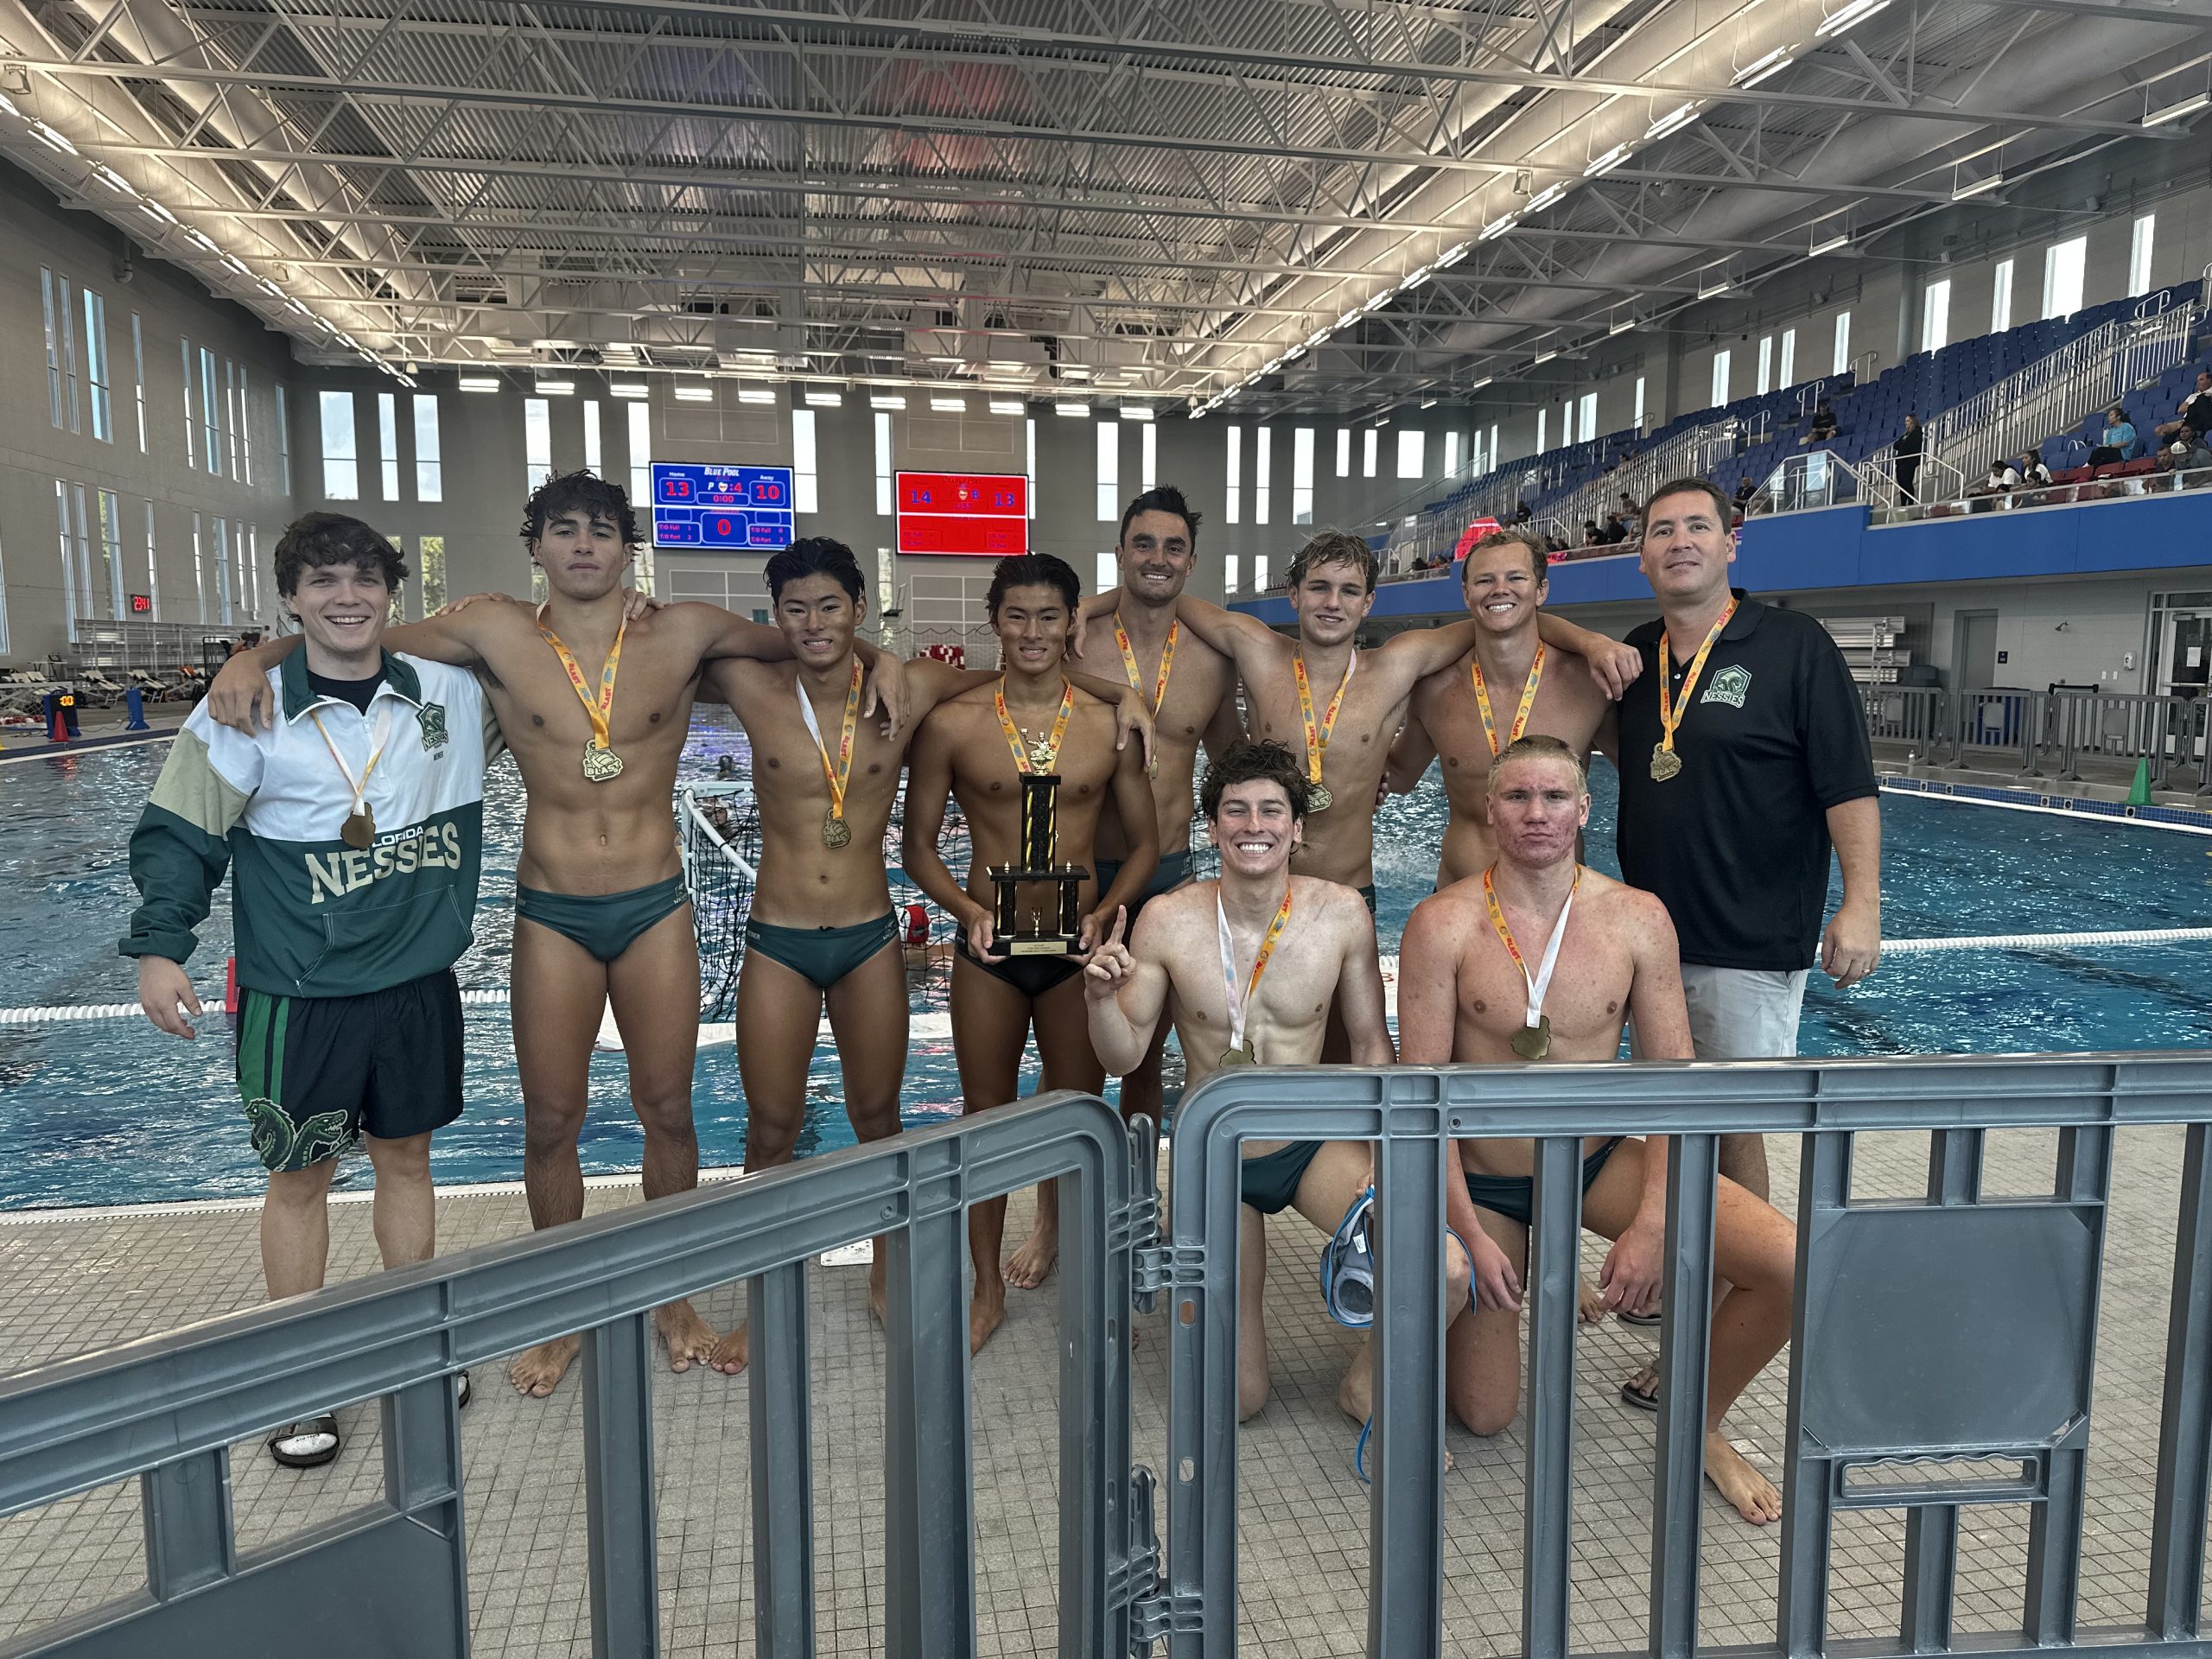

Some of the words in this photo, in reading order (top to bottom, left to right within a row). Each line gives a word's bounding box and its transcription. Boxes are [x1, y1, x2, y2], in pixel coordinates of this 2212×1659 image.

[722, 467, 740, 476] POOL
[665, 481, 690, 497] 13
[756, 485, 779, 499] 10
[911, 490, 931, 504] 14
[995, 493, 1015, 506] 13
[717, 518, 732, 536] 0
[1717, 607, 1733, 627] BLAST
[1534, 651, 1544, 670] BLAST
[1684, 671, 1697, 692] BLAST
[601, 688, 612, 710] BLAST
[1701, 691, 1744, 707] NESSIES
[1325, 706, 1337, 725] BLAST
[1513, 716, 1524, 736] BLAST
[587, 760, 621, 775] BLAST
[372, 825, 424, 848] LORIDA
[304, 822, 461, 905] NESSIES
[1506, 938, 1522, 960] BLAST
